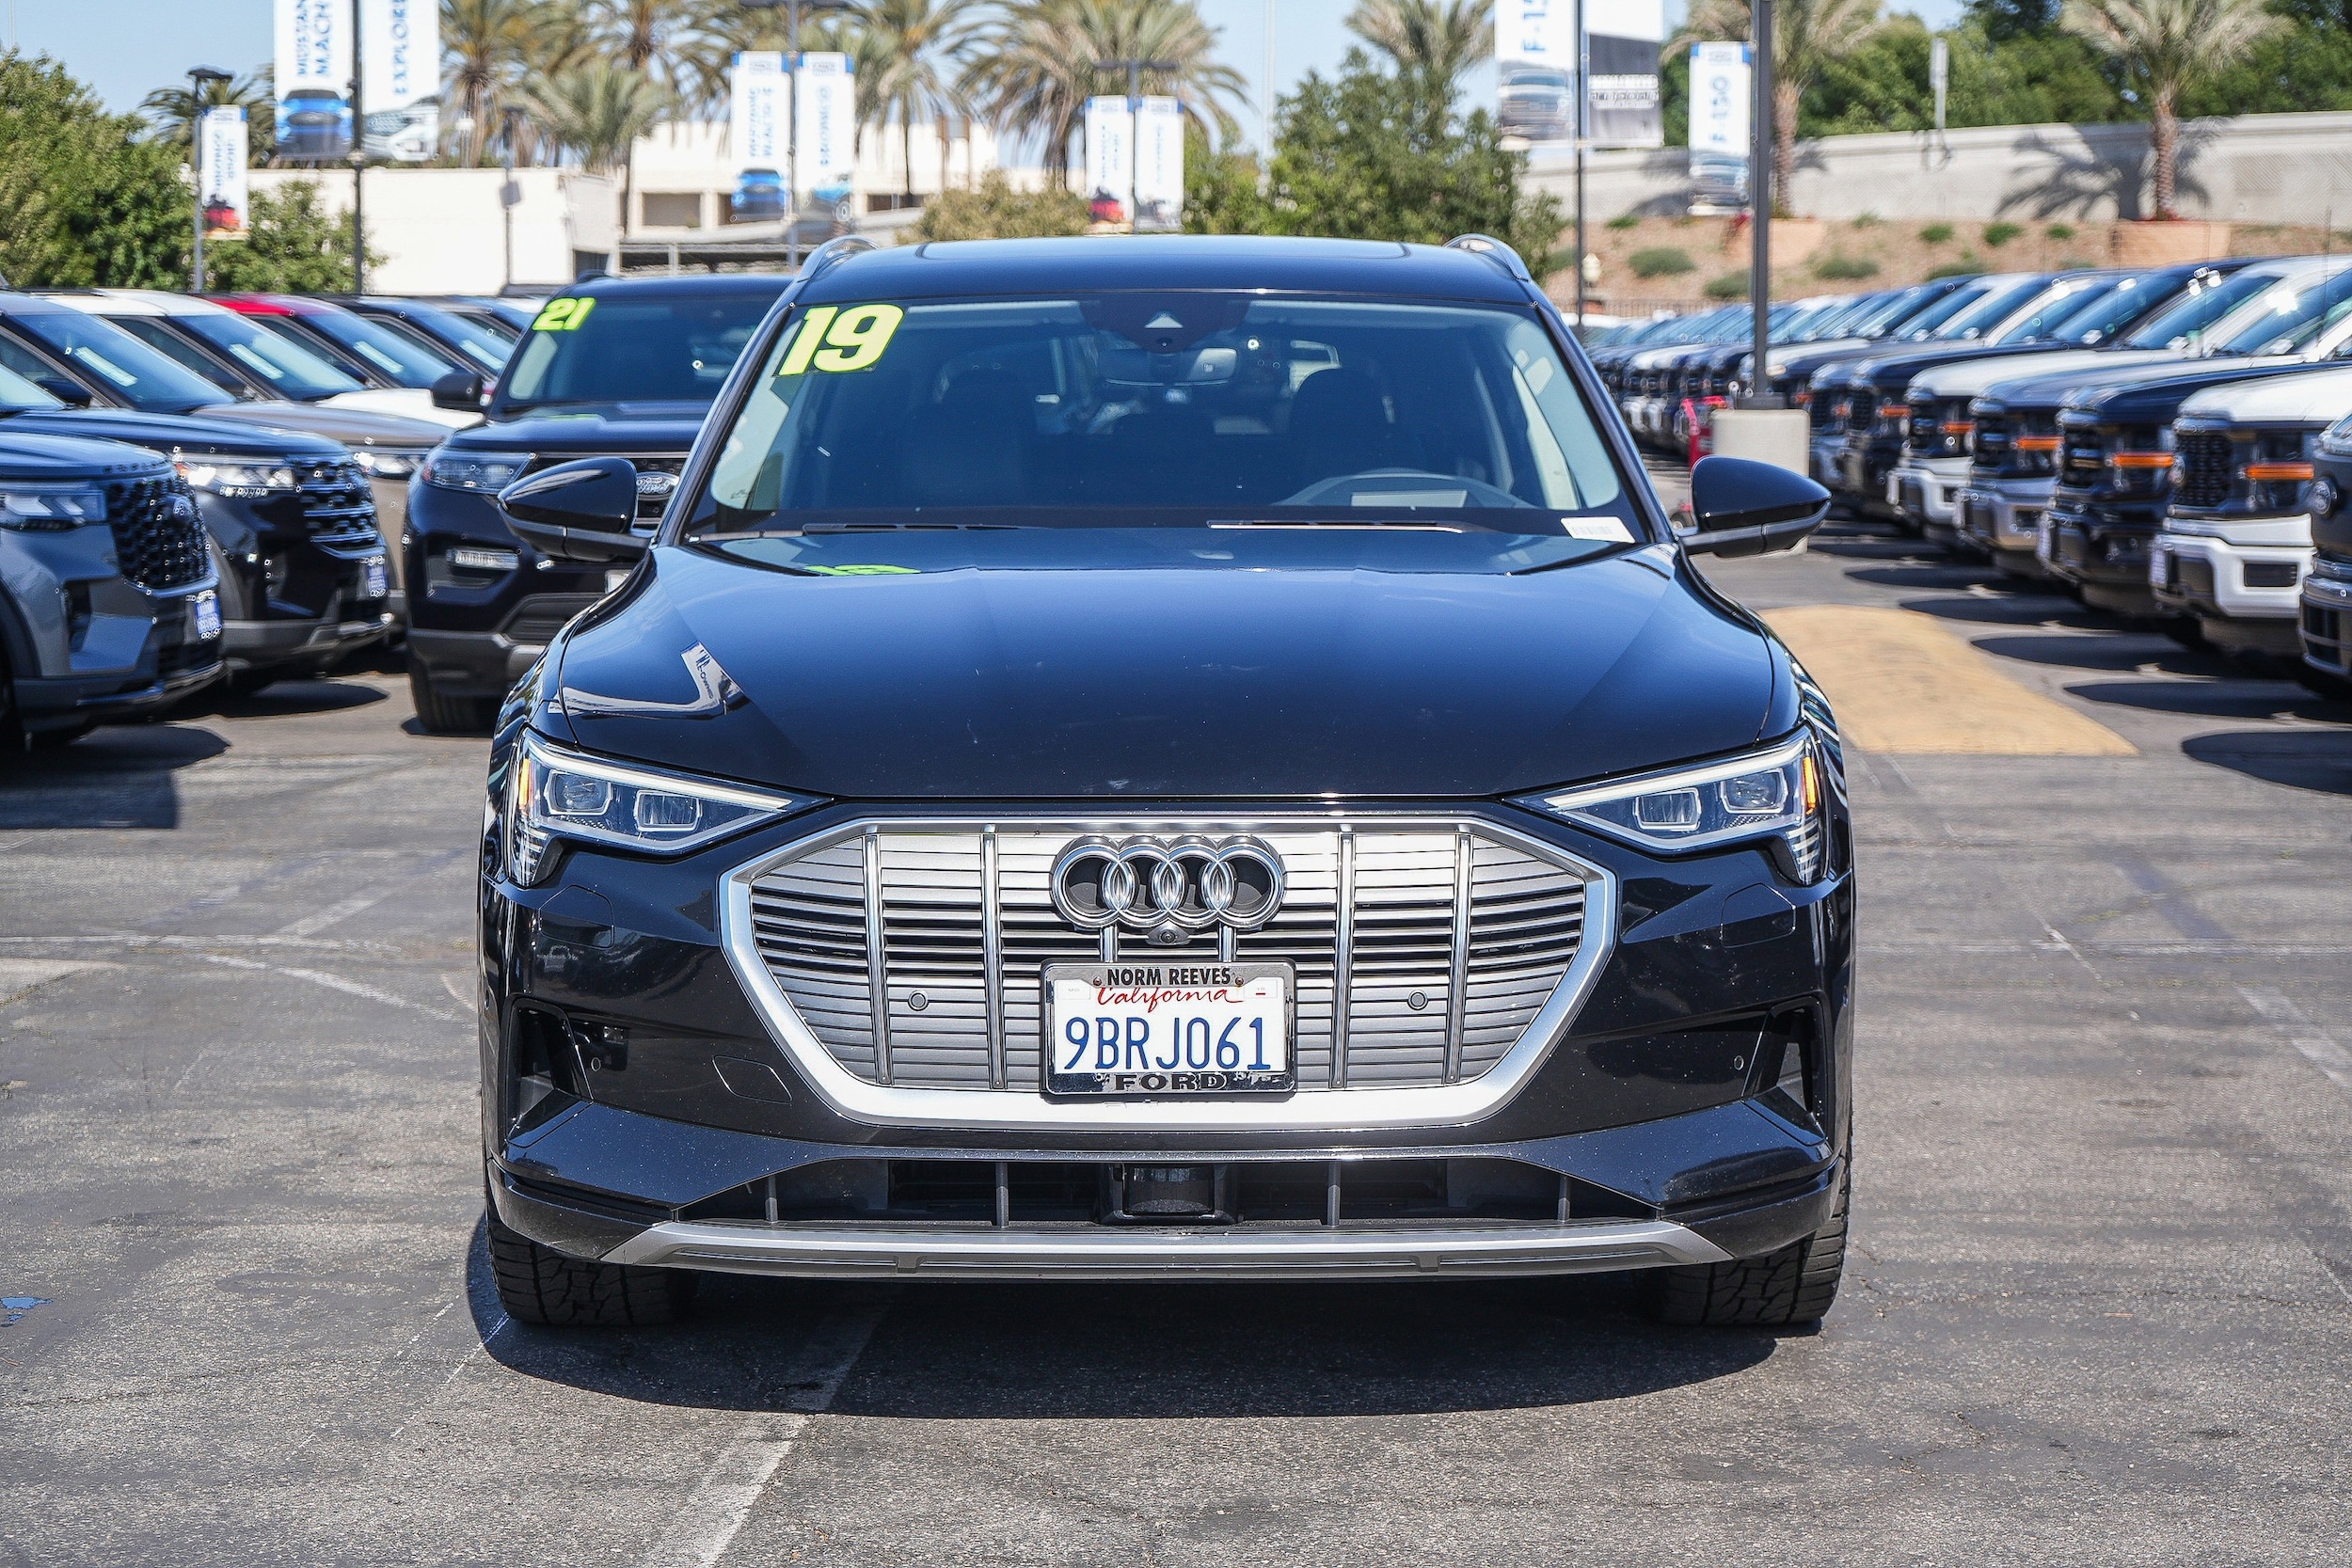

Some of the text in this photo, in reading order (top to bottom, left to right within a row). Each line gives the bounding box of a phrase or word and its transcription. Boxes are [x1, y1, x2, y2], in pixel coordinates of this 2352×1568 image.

[1710, 76, 1729, 141] F-150
[532, 297, 596, 331] 21
[778, 304, 905, 376] 19
[1107, 968, 1232, 986] NORM REEVES
[1096, 987, 1245, 1013] California
[1064, 1017, 1271, 1069] 9BRJ061
[1114, 1072, 1228, 1091] FORD
